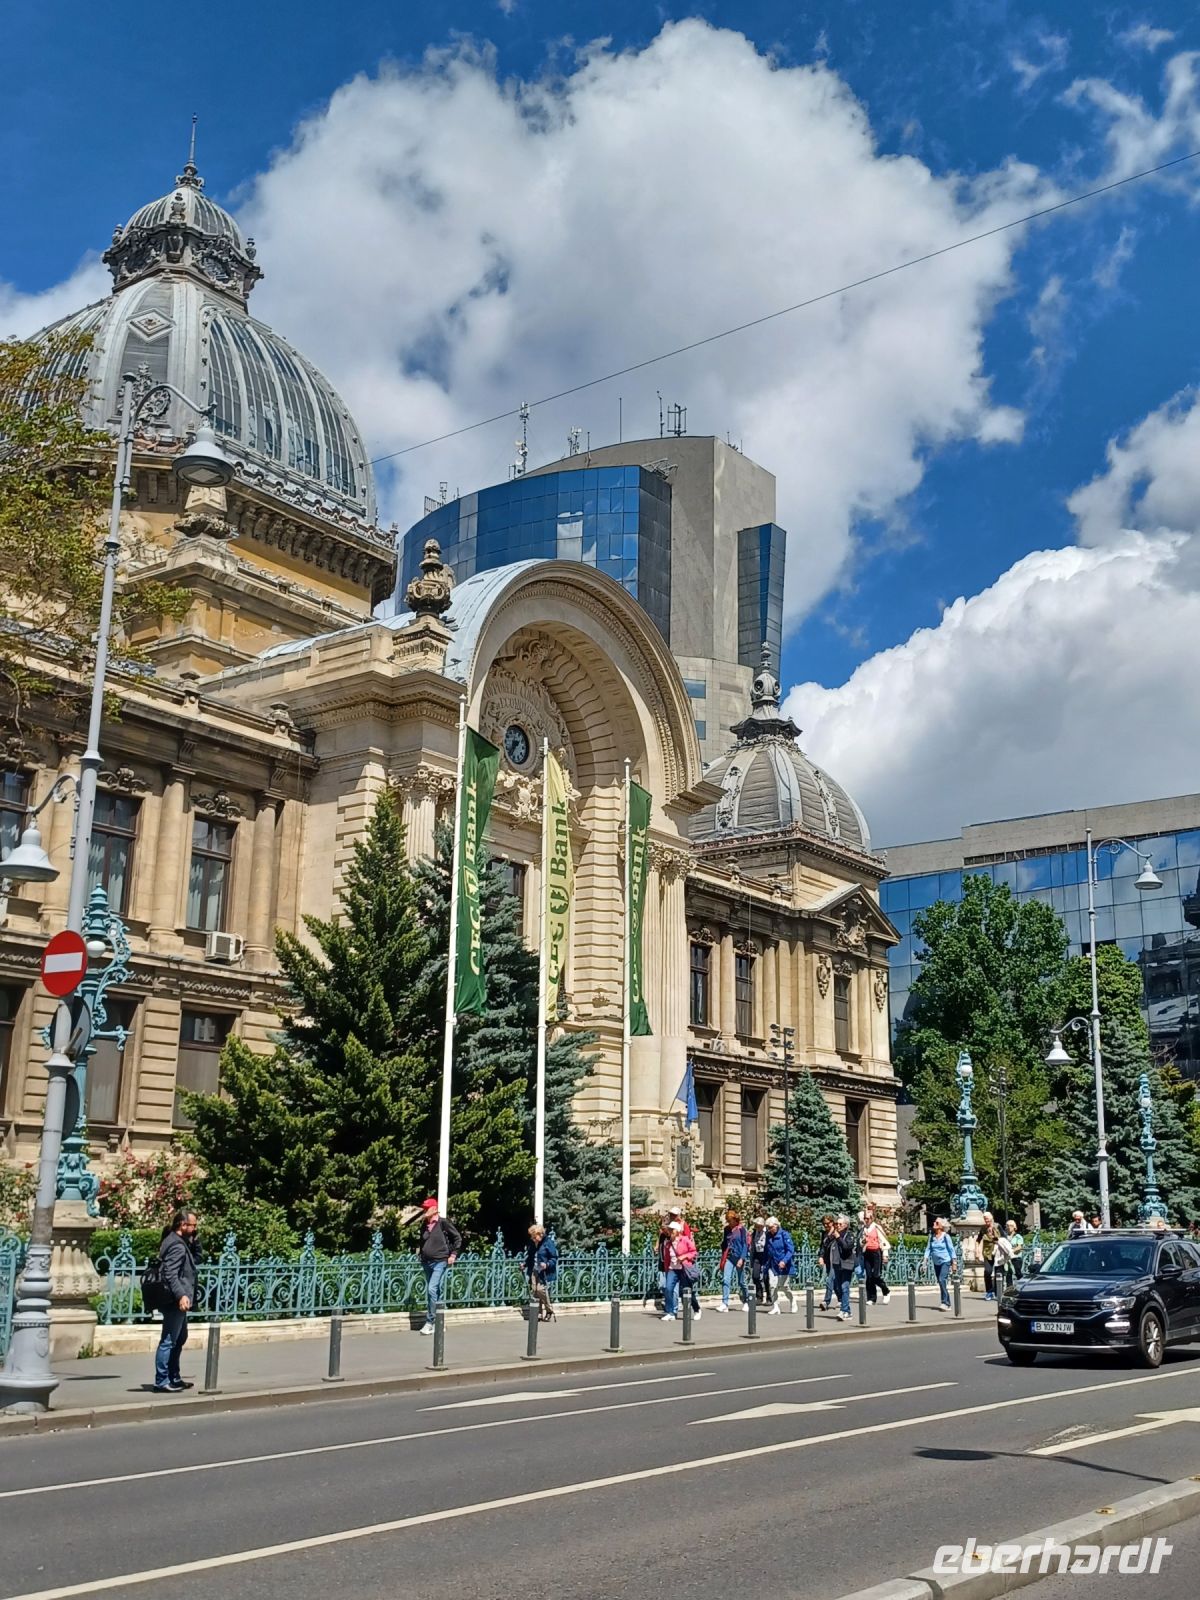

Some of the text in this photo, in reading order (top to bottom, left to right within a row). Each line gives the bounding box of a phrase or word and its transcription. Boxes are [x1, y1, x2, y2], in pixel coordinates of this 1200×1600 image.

[465, 779, 477, 864] Bank
[550, 799, 568, 879] Bank
[1036, 1322, 1072, 1331] B 102 NJW
